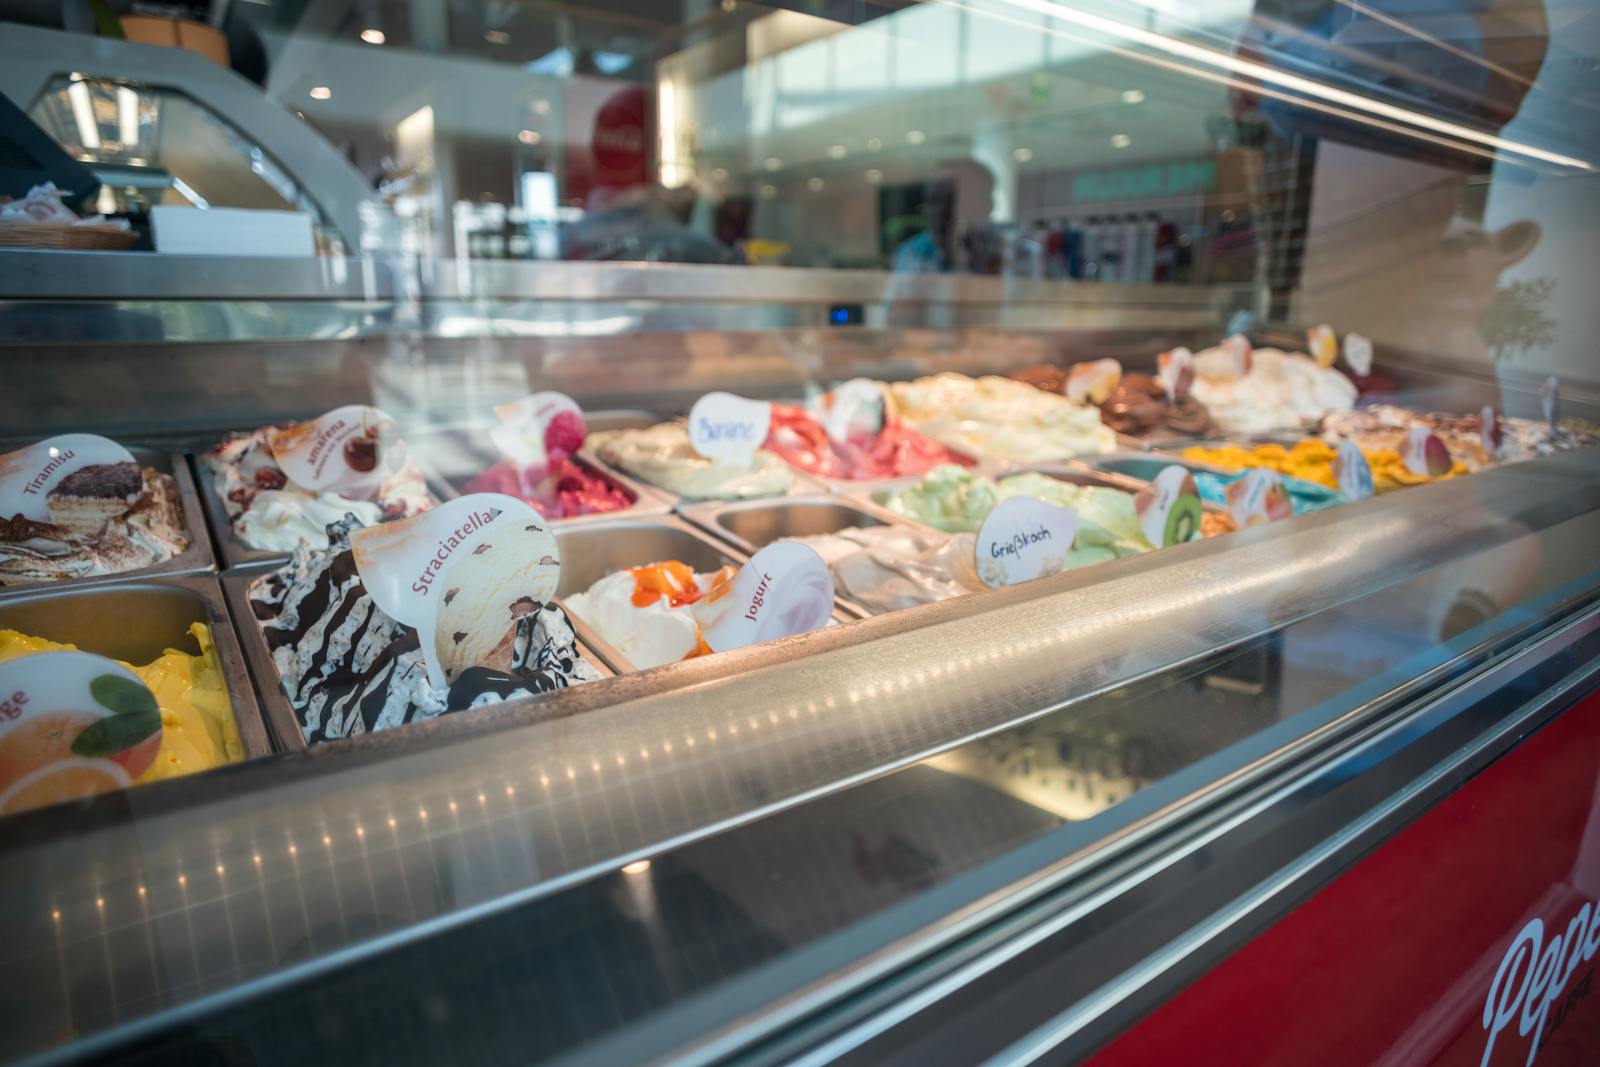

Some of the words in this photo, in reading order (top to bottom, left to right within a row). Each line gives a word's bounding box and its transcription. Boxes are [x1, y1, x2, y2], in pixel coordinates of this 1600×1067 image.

[308, 419, 346, 466] amarena
[23, 449, 76, 495] Tiramisu
[412, 510, 494, 596] Straciatella
[991, 524, 1052, 561] Grießkoch
[745, 572, 773, 622] Jogurt
[0, 690, 31, 724] ge
